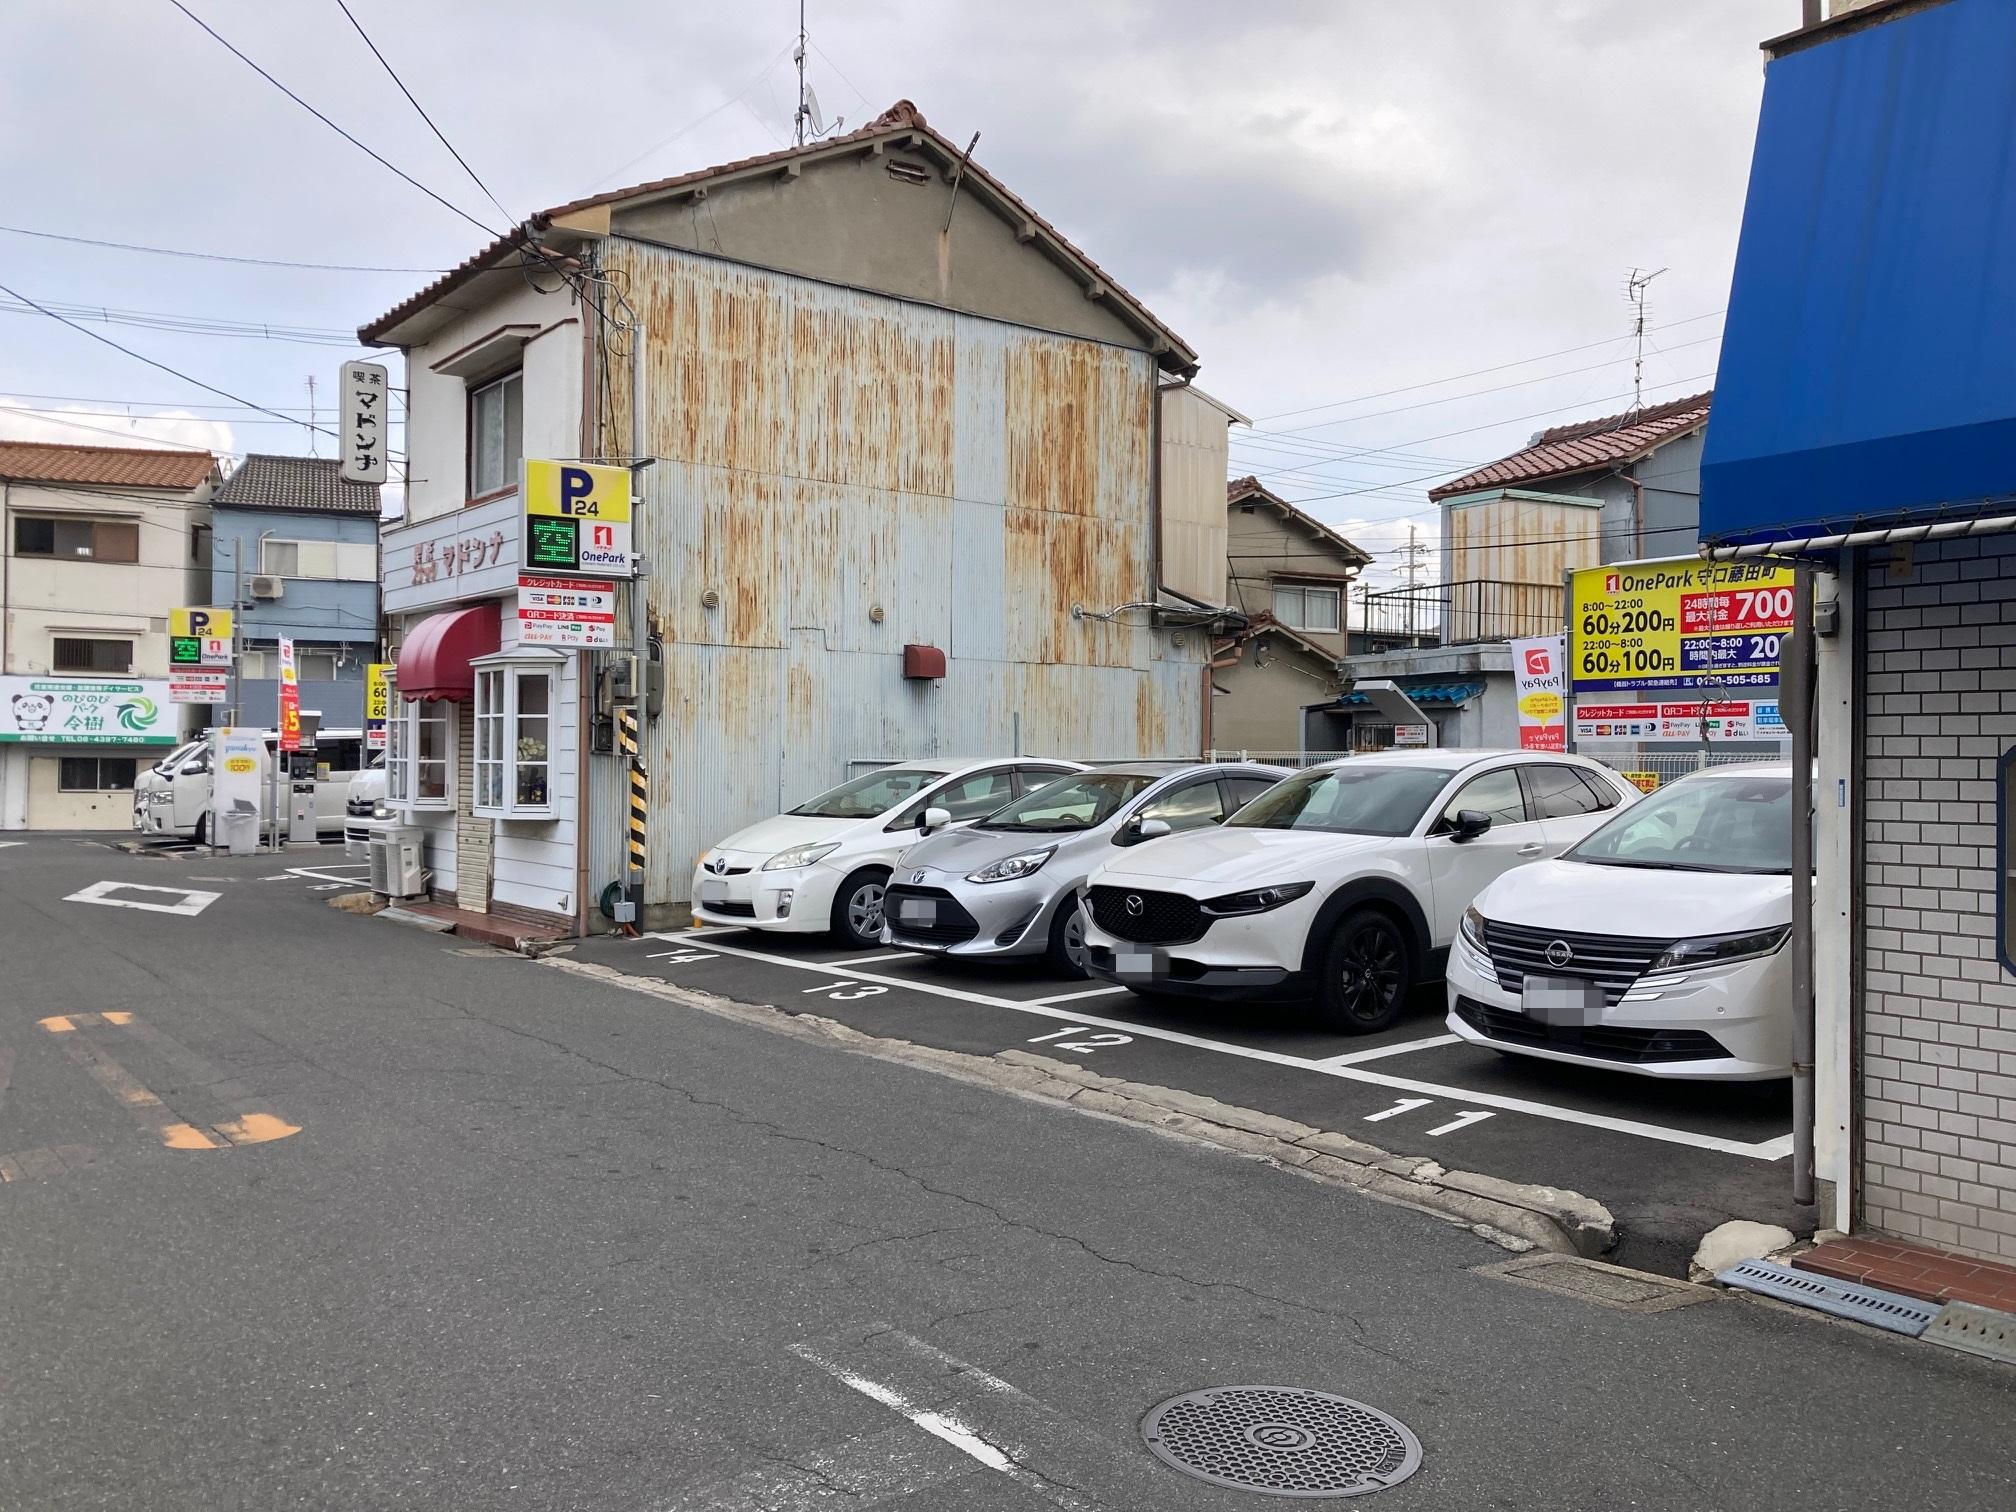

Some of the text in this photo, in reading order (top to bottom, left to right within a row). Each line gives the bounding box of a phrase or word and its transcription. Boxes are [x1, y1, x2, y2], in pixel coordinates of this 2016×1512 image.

[353, 371, 381, 385] 喫茶
[355, 390, 378, 471] マドンナ
[561, 467, 599, 516] P 24
[534, 521, 574, 562] 空
[582, 551, 625, 563] OnePark
[527, 579, 574, 588] クレジットカード
[1622, 570, 1693, 592] OnePark
[1583, 599, 1643, 612] 8:00～22:00
[1735, 588, 1793, 620] 700
[190, 612, 209, 635] P
[527, 610, 574, 621] QRコード決済
[1583, 610, 1674, 635] 60分200円
[1583, 638, 1643, 650] 22:00～8:00
[1583, 649, 1674, 673] 60分100円
[1579, 709, 1624, 718] クレジットカード
[646, 949, 720, 964] 14
[801, 981, 888, 1000] 13
[1027, 1026, 1133, 1054] 12
[1363, 1098, 1496, 1136] 11
